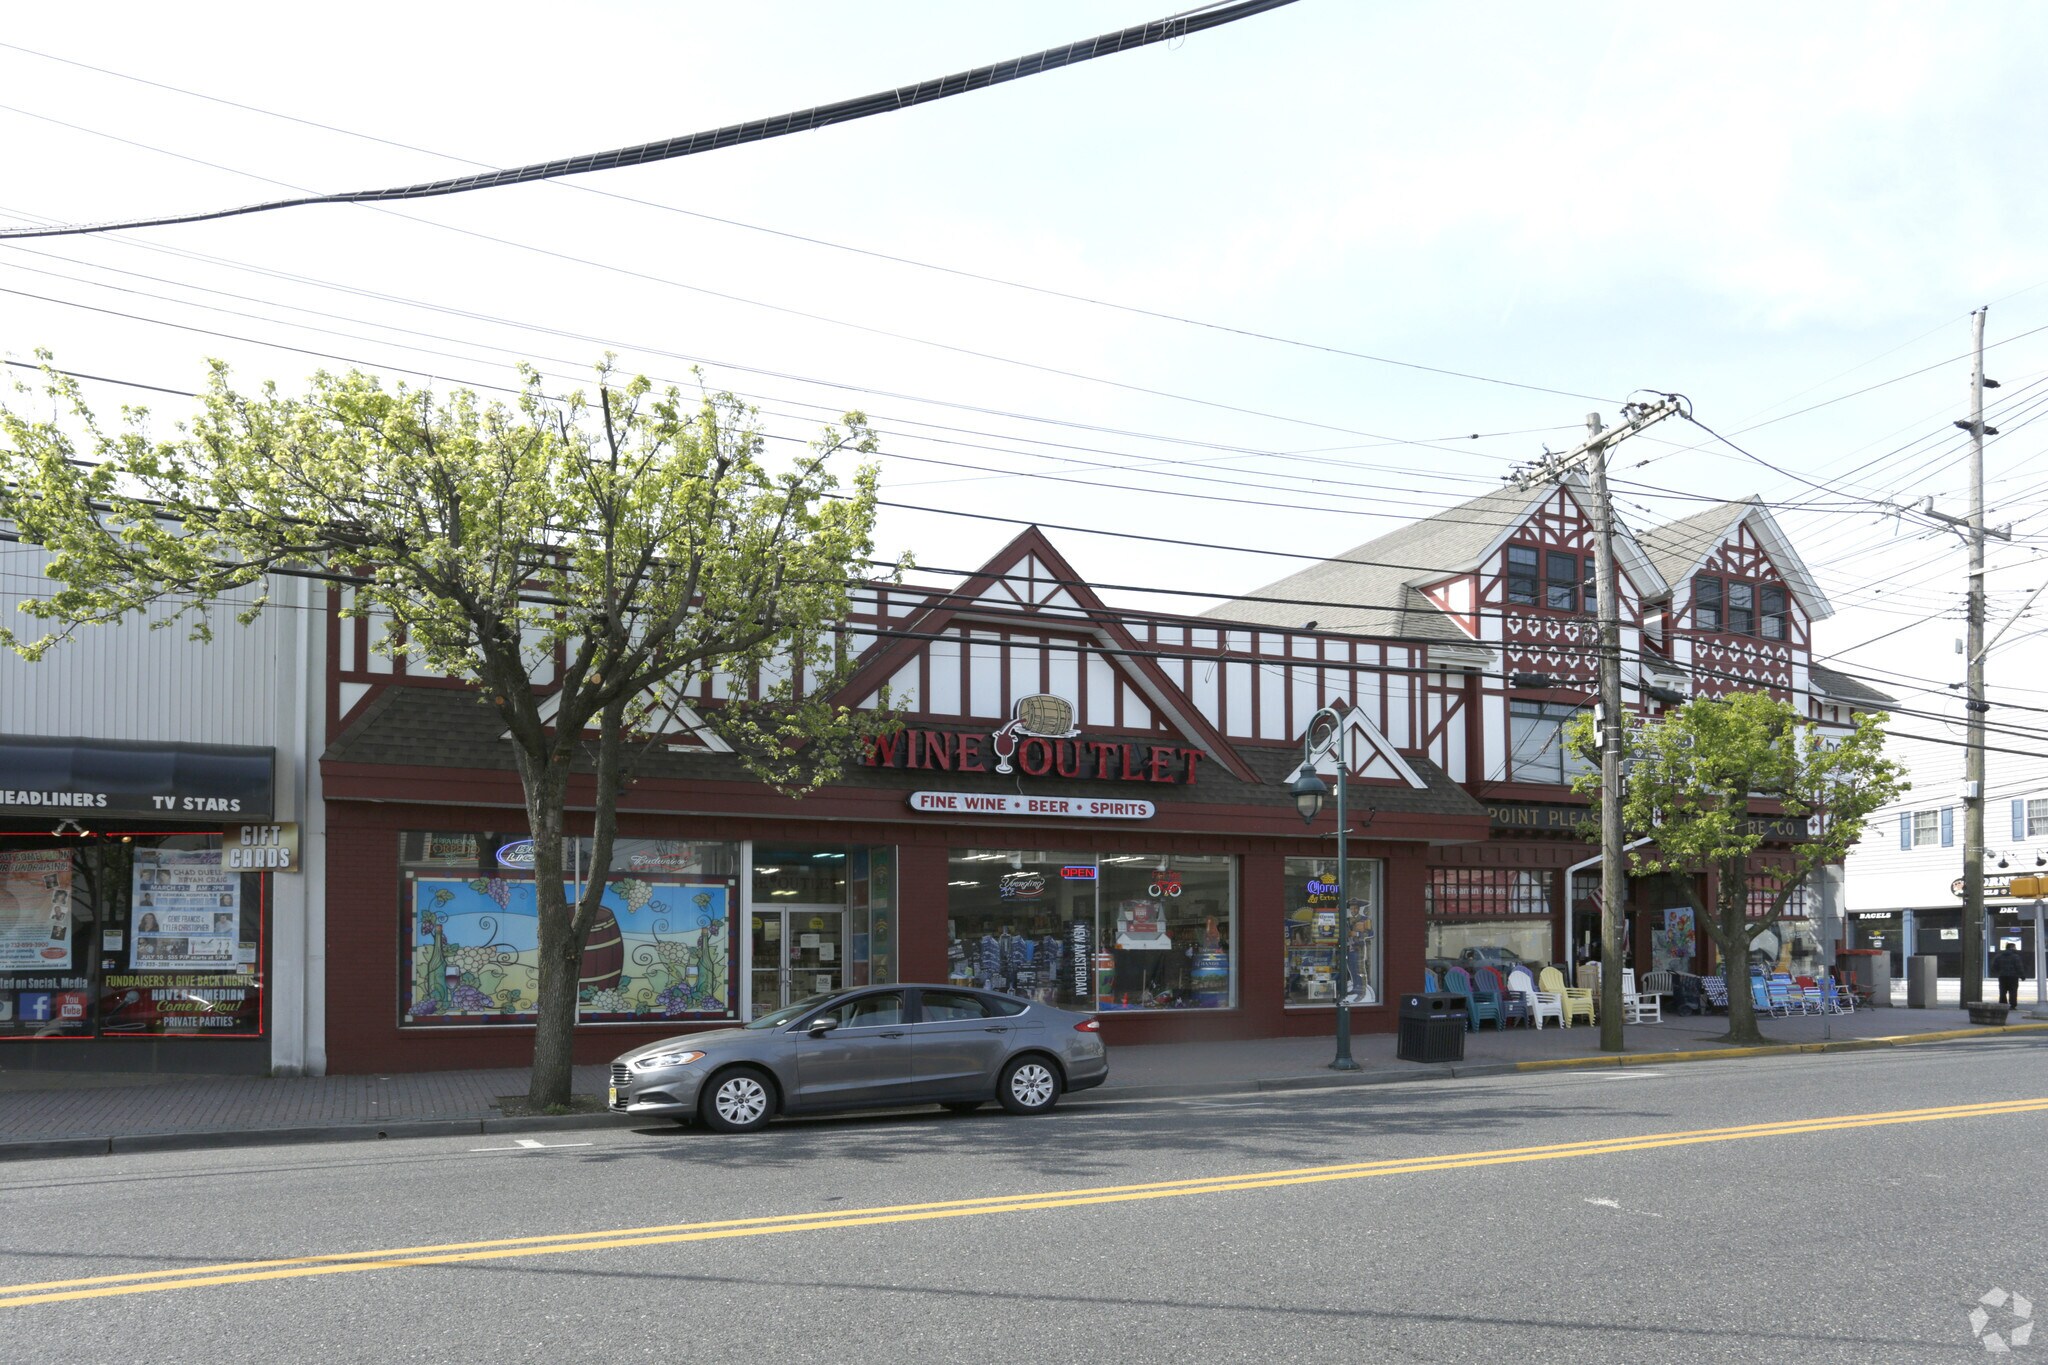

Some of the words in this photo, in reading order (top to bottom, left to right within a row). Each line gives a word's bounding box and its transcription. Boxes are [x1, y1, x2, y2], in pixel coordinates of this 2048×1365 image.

[862, 727, 986, 772] WINE
[1018, 737, 1206, 784] OUTLET
[152, 796, 176, 810] TV
[182, 797, 241, 812] STARS
[920, 795, 957, 809] FINE
[964, 797, 1007, 811] WINE
[1028, 800, 1069, 813] BEER
[1090, 802, 1147, 816] SPIRITS
[1488, 808, 1539, 825] POINT
[1548, 811, 1600, 827] PLEAS
[240, 825, 280, 846] GIFT
[515, 845, 535, 854] BU
[229, 848, 290, 868] CARDS
[506, 853, 536, 862] LIG
[1061, 868, 1094, 877] OPEN
[1307, 880, 1339, 895] Coron
[1074, 924, 1086, 943] NEW
[1074, 944, 1088, 996] AMSTERDAM
[15, 979, 28, 989] on
[61, 977, 88, 989] Media
[105, 975, 164, 987] FUNDRAISERS
[166, 976, 174, 987] &
[175, 975, 195, 987] GIVE
[198, 975, 220, 987] BACK
[222, 974, 254, 987] NIGHTS
[65, 995, 78, 1004] You
[151, 989, 178, 1000] HAVE
[191, 989, 245, 1000] COMEDIAN
[63, 1006, 81, 1015] Tube
[156, 1000, 192, 1012] Come
[213, 1000, 242, 1014] You!
[163, 1017, 197, 1027] PRIVATE
[199, 1017, 233, 1027] PARTIES
